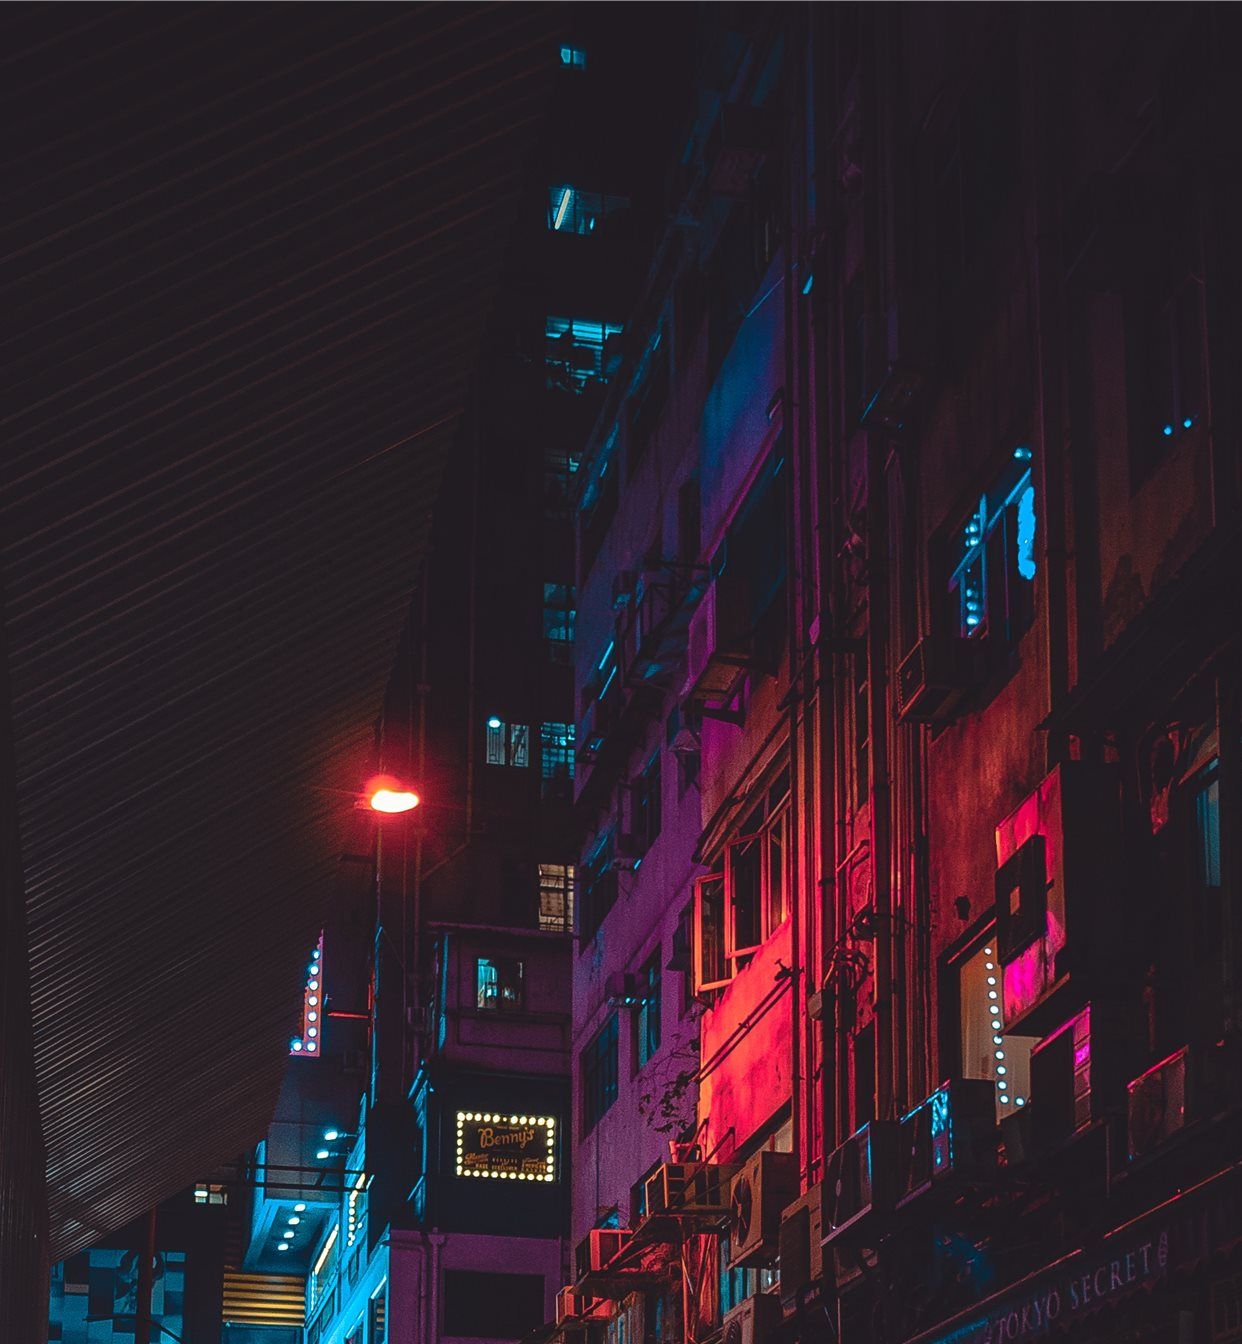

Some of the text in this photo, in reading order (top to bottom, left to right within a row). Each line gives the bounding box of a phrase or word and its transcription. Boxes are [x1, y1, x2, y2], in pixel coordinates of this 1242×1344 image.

[478, 1126, 535, 1149] Benny's
[996, 1243, 1152, 1344] TOKYO SECRET
